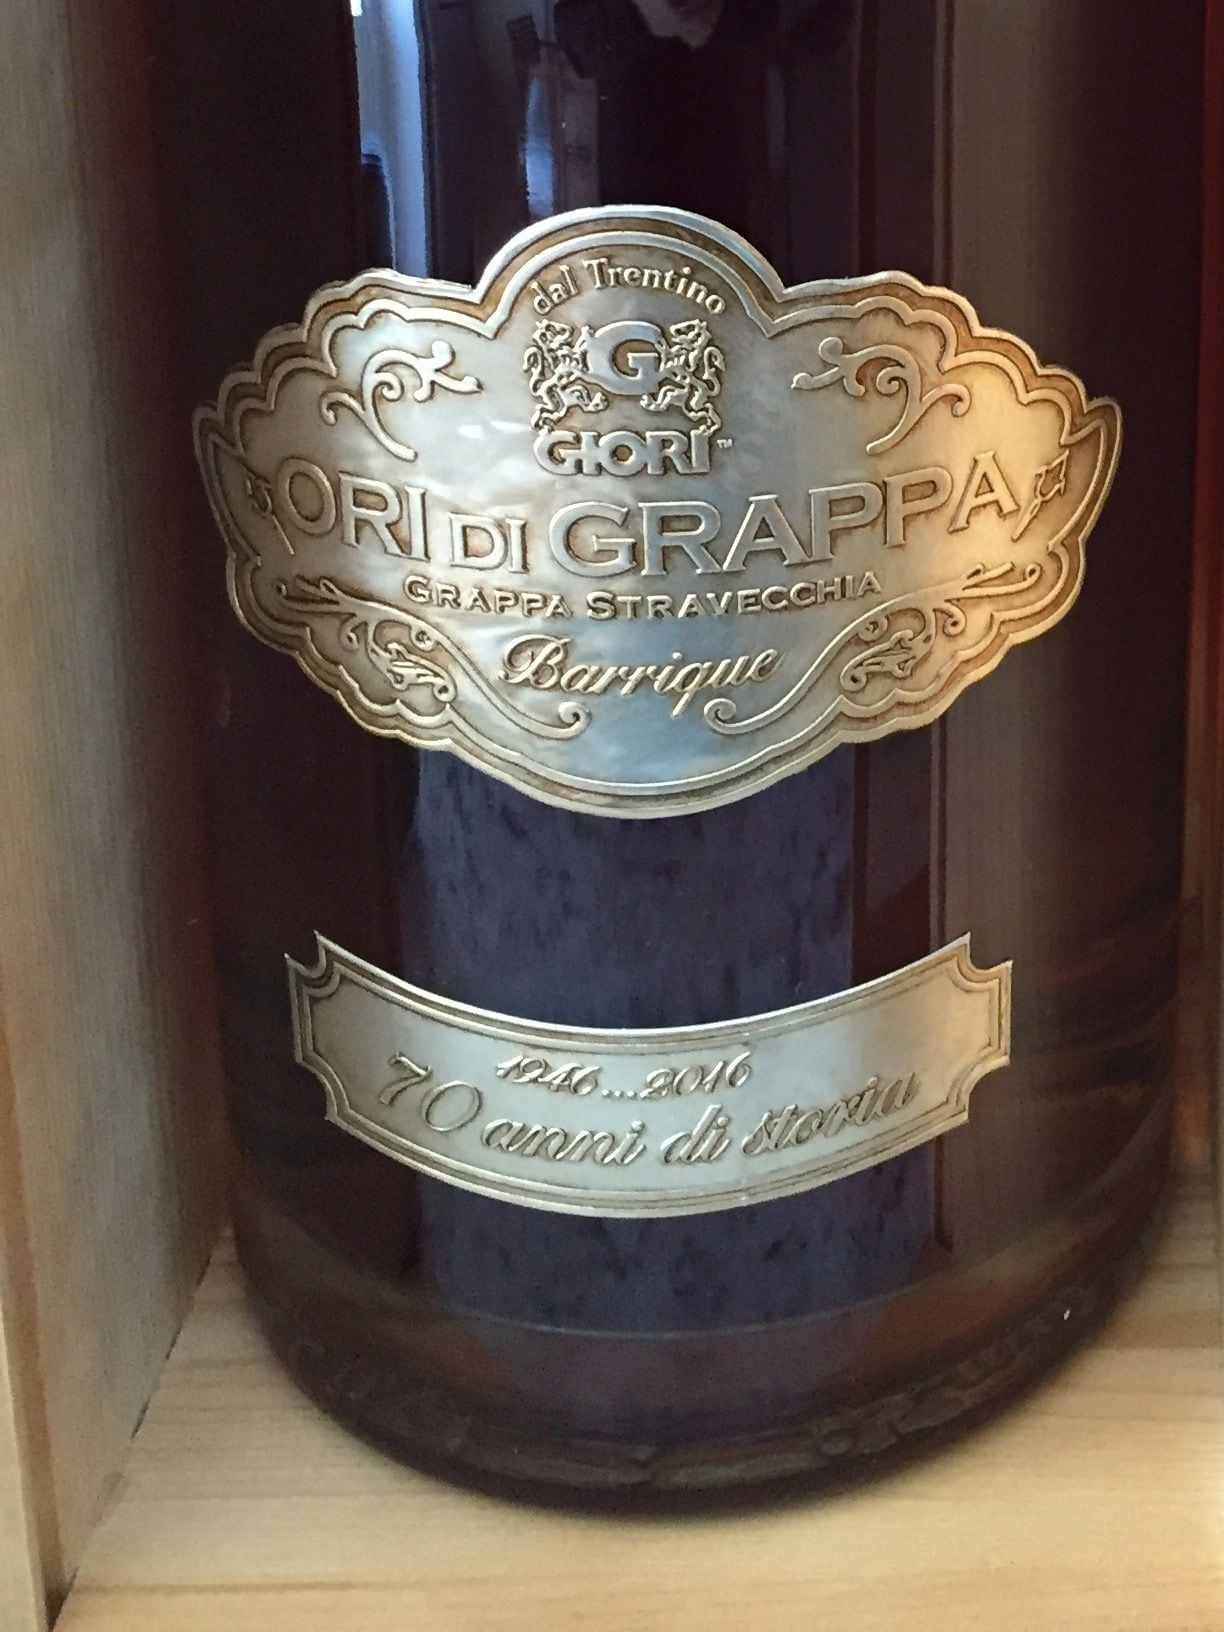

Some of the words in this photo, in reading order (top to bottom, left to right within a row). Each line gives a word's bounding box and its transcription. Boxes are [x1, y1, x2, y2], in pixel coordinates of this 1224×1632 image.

[529, 265, 580, 316] dal
[582, 257, 727, 316] Trentino
[587, 320, 665, 396] G
[533, 429, 711, 476] GIORI
[282, 457, 430, 563] ORI
[450, 518, 528, 574] DI
[549, 450, 1019, 578] GRAPPA
[403, 574, 575, 620] GRAPPA
[587, 570, 883, 622] STRAVECCHIA
[498, 633, 786, 720] Barrique
[378, 1051, 483, 1135] 70
[480, 1119, 648, 1168] anni
[660, 1103, 734, 1166] di
[741, 1072, 922, 1158] storia
